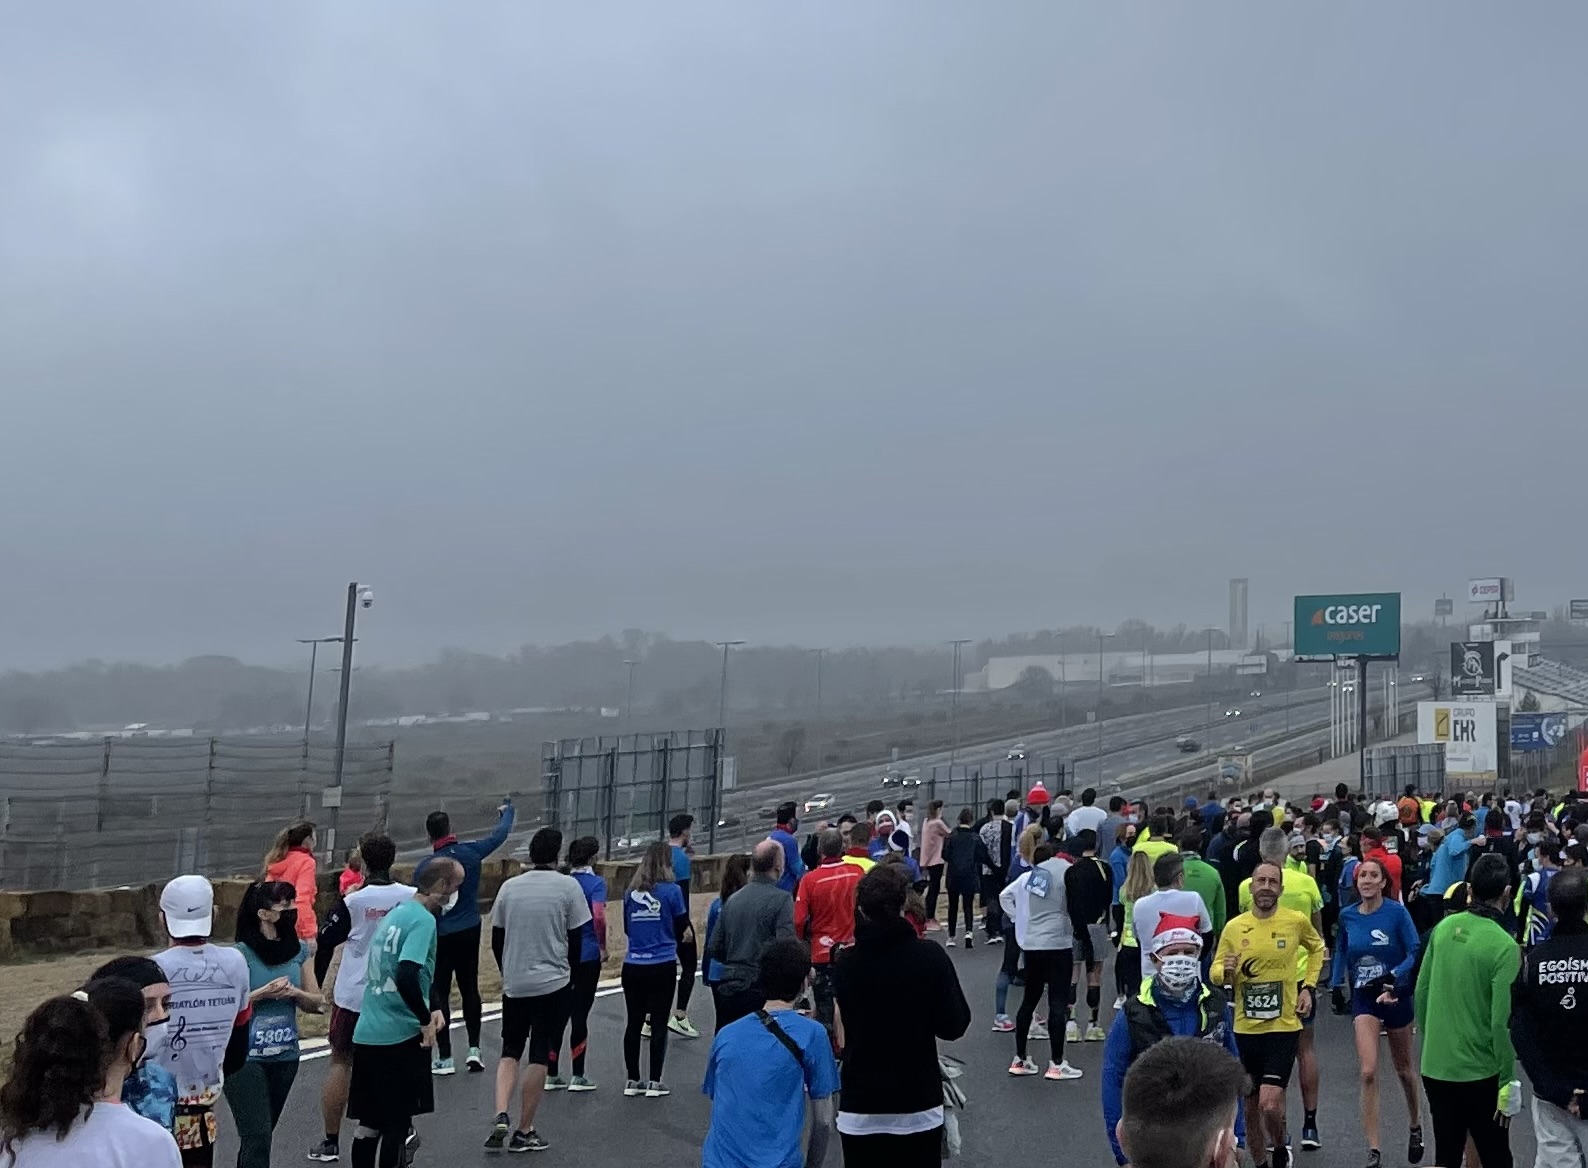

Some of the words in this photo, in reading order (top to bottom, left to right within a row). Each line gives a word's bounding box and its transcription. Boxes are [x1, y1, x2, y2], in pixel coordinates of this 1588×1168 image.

[1324, 604, 1382, 625] caser
[383, 925, 402, 955] 21
[1246, 994, 1279, 1009] 5624
[254, 1027, 294, 1046] 5802
